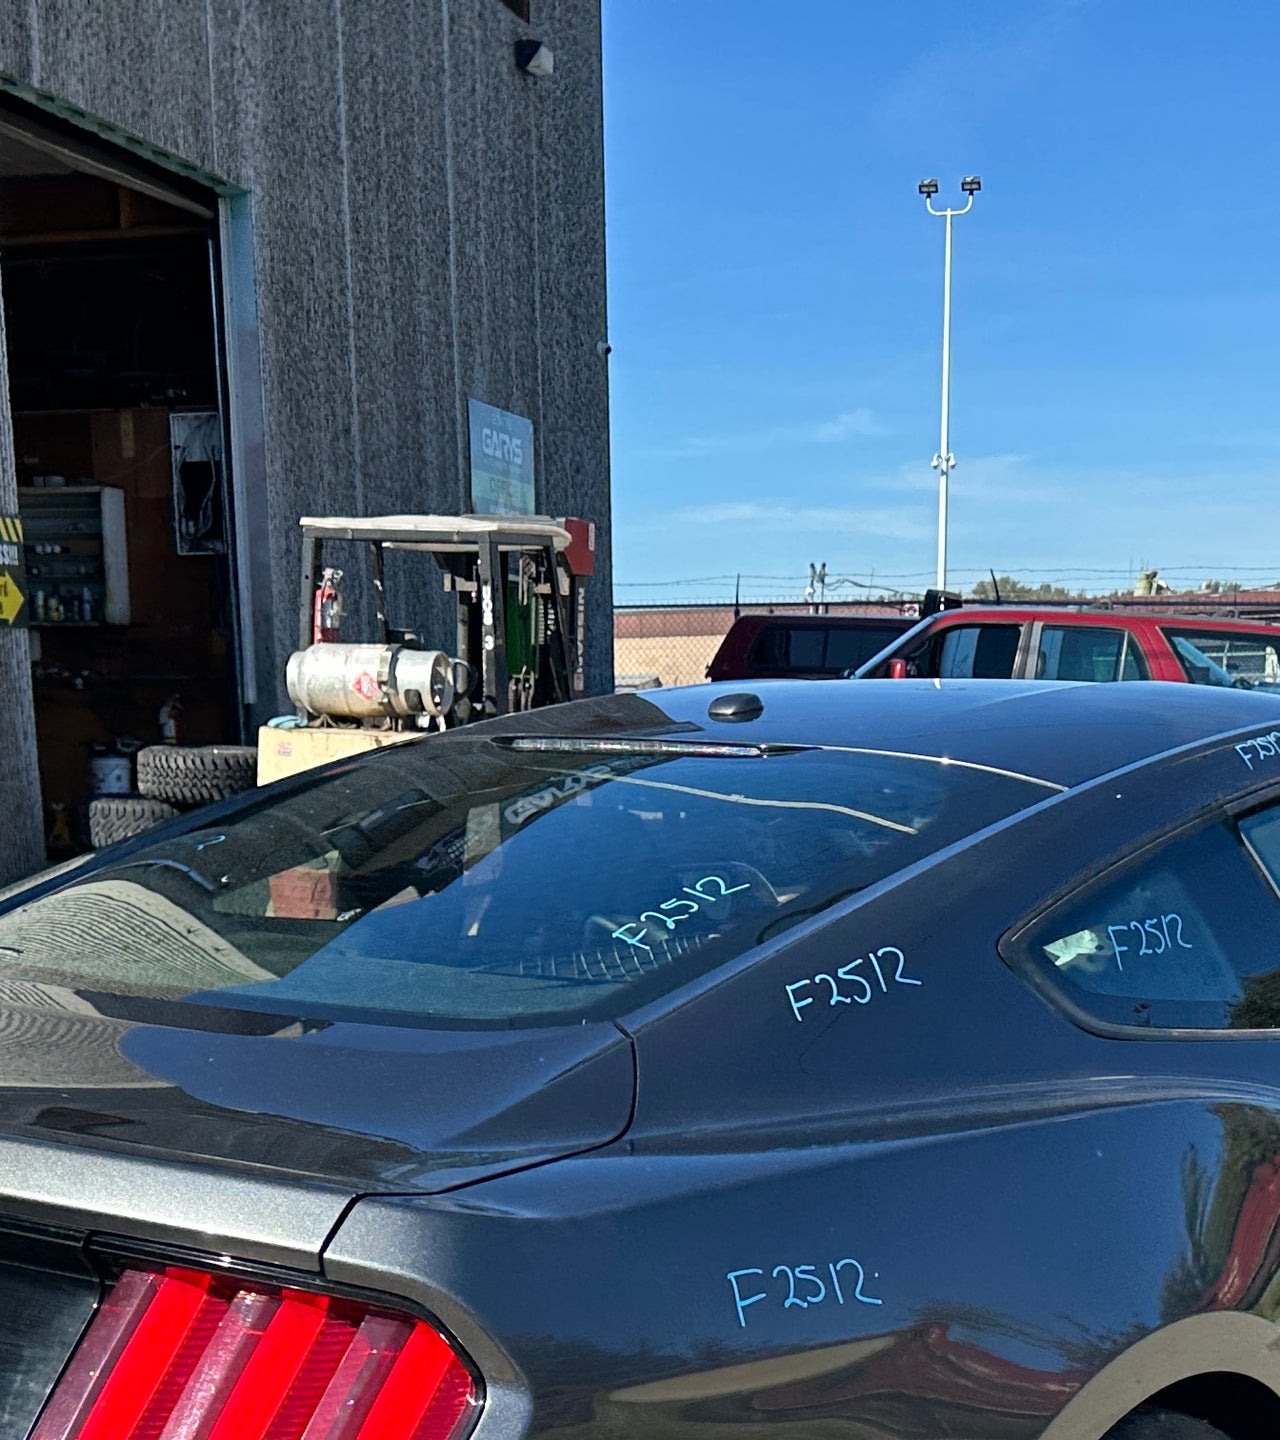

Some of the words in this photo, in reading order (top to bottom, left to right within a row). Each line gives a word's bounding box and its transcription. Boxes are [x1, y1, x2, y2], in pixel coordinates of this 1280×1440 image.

[482, 427, 523, 465] GARYS
[612, 875, 751, 950] F2512
[1108, 913, 1193, 972] F2512
[785, 946, 922, 1022] F2512
[727, 1258, 883, 1328] F2512
